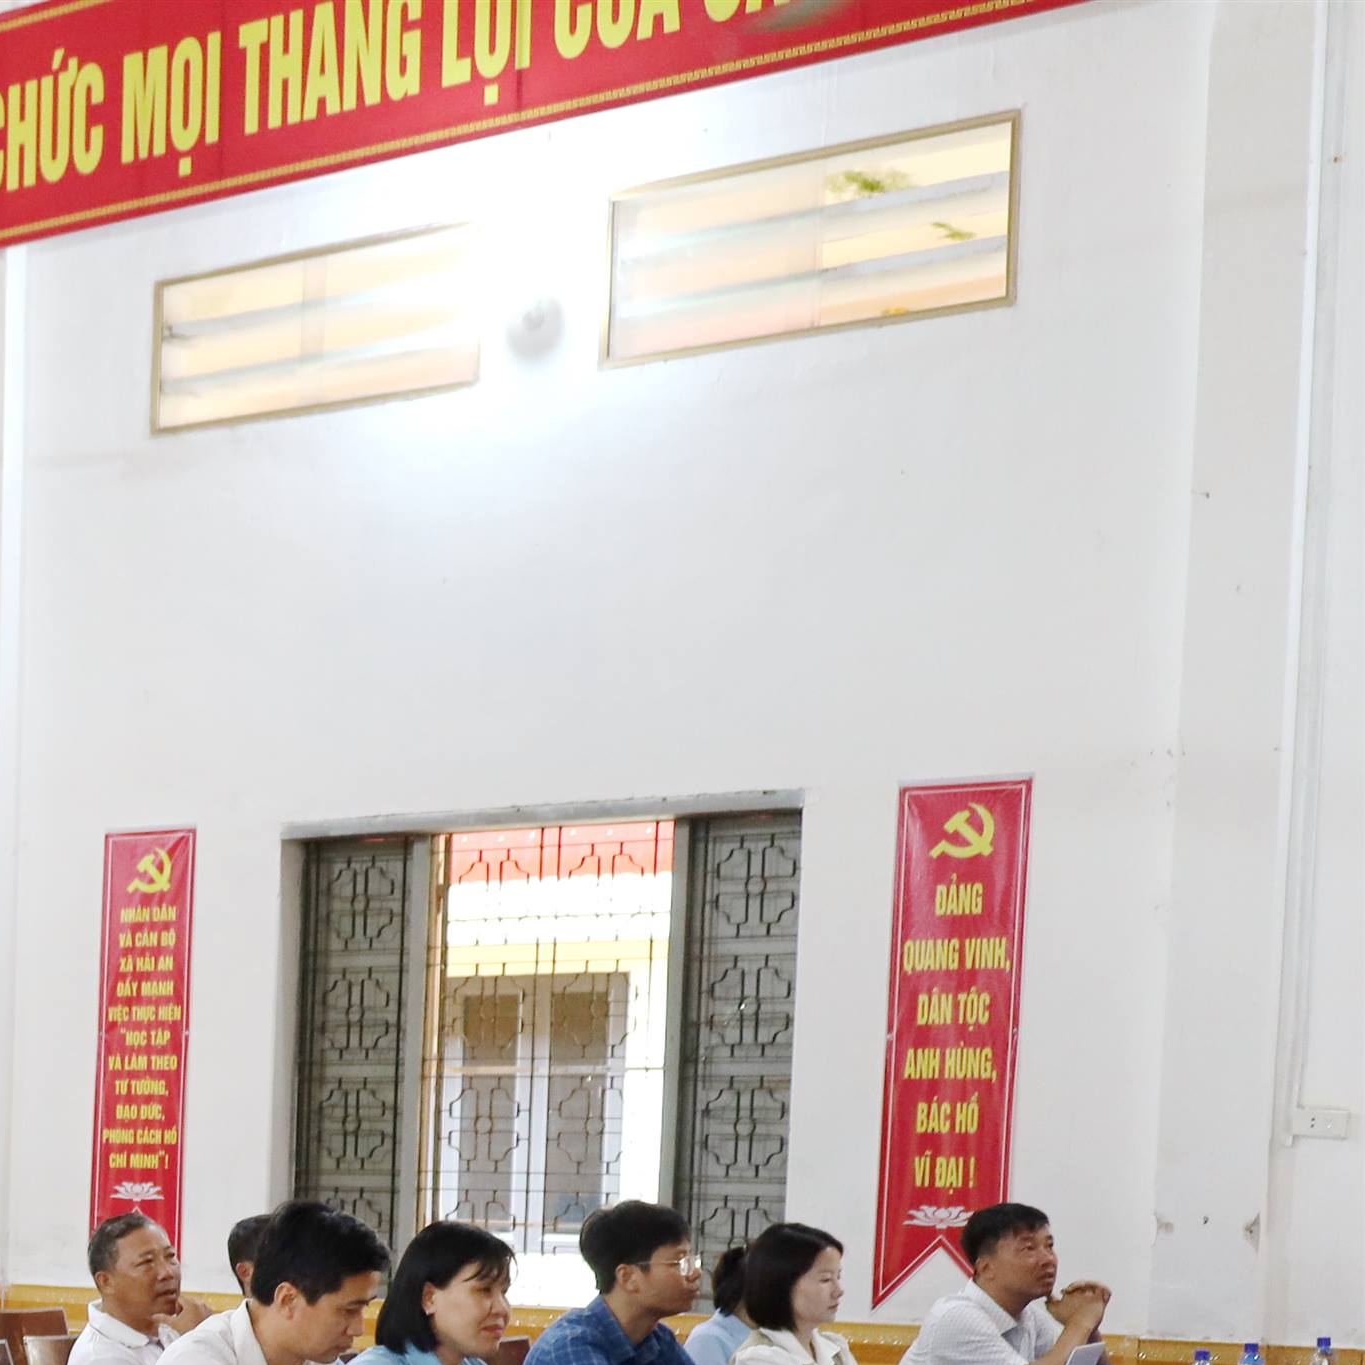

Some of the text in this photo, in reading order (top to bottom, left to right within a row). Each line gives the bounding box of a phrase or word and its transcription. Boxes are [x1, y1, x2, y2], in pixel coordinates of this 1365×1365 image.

[120, 30, 221, 177] MỌI
[934, 872, 983, 916] ĐẢNG
[120, 902, 177, 923] NHÂN DÂN
[119, 929, 133, 948] VÀ
[160, 928, 176, 949] BỘ
[157, 955, 174, 971] AN
[903, 936, 1011, 976] QUANG VINH,
[916, 985, 990, 1032] DÂN TỘC
[108, 1053, 178, 1071] VÀ LÀM THEO
[903, 1041, 998, 1084] ANH HÙNG,
[115, 1104, 138, 1123] ĐẠO
[916, 1095, 951, 1134] BÁC
[136, 1126, 162, 1144] CÁCH
[109, 1150, 127, 1169] CHÍ
[914, 1149, 933, 1188] VĨ
[934, 1155, 964, 1195] ĐẠI
